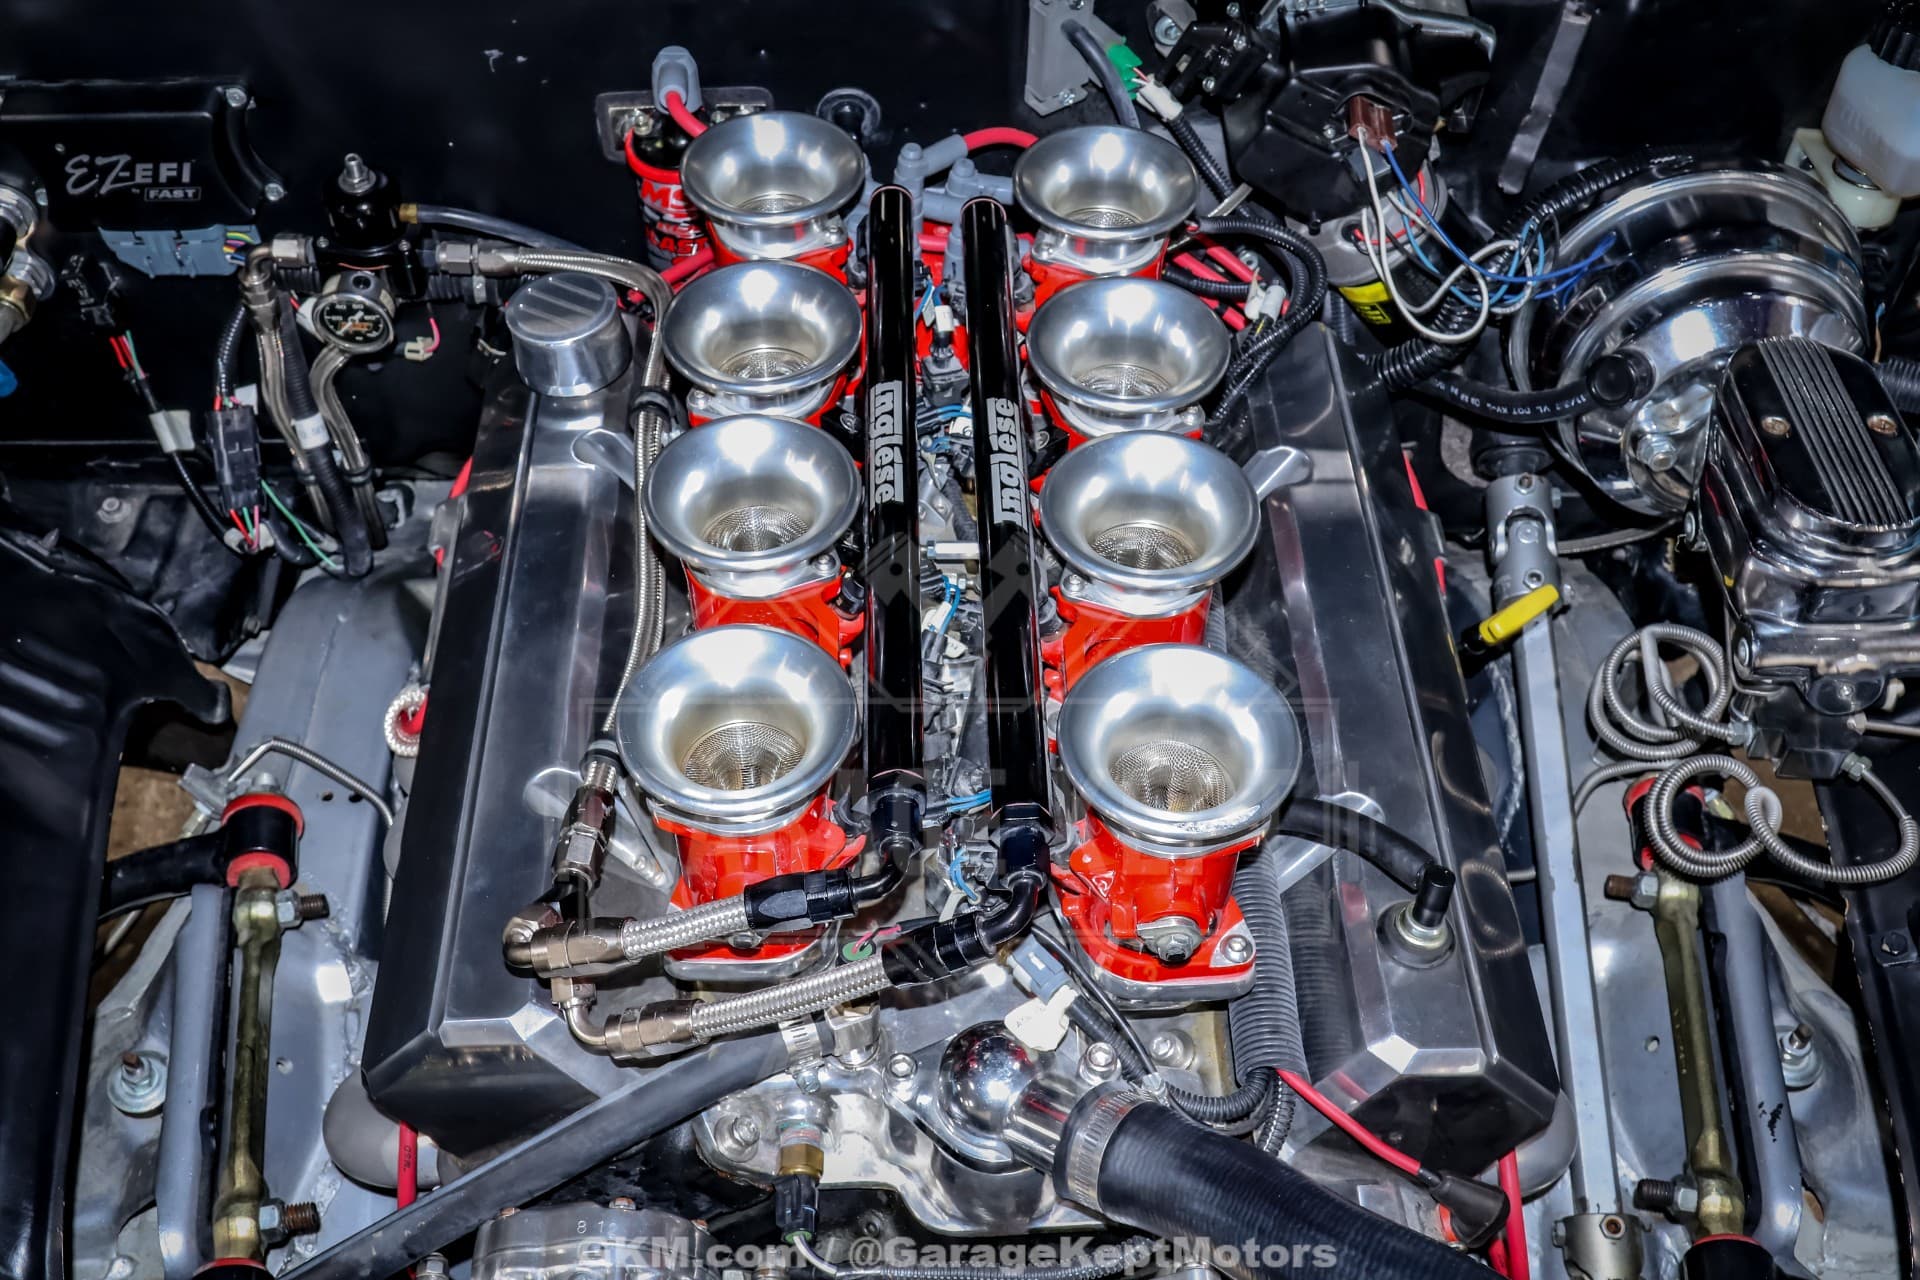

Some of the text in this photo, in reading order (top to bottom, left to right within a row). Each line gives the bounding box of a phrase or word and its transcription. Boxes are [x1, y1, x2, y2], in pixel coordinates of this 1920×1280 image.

[149, 189, 196, 199] FAST
[870, 380, 904, 512] Inglese
[986, 397, 1028, 533] Inglese
